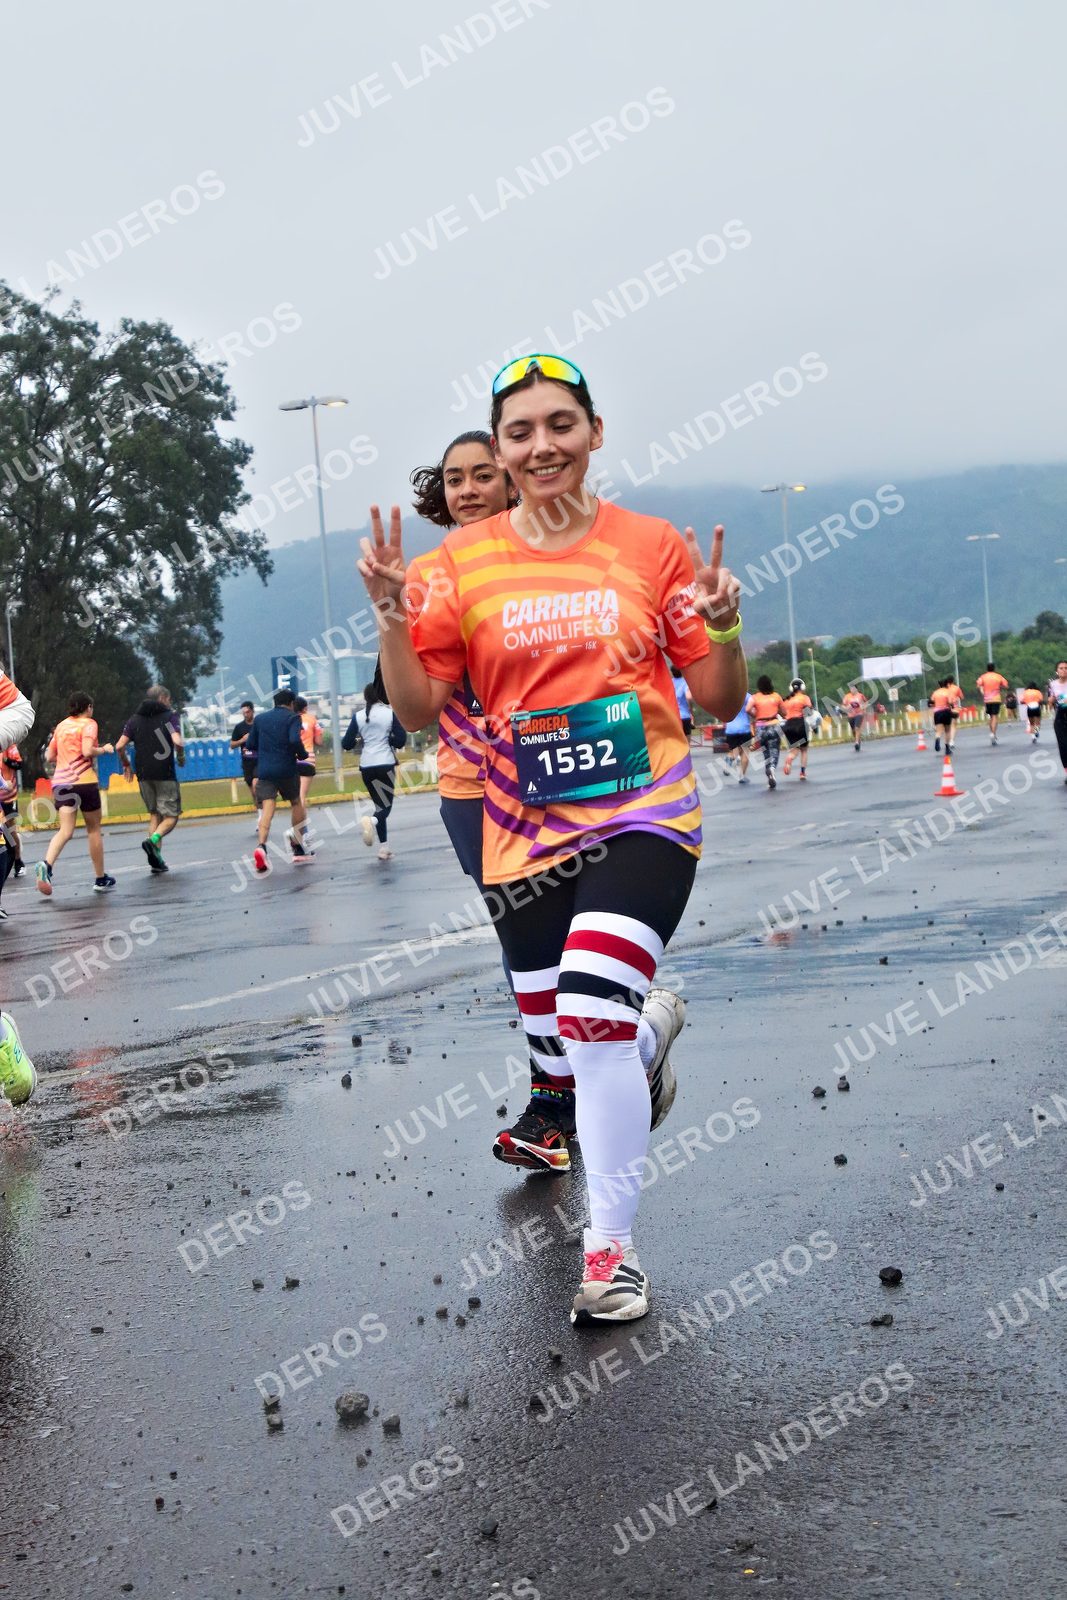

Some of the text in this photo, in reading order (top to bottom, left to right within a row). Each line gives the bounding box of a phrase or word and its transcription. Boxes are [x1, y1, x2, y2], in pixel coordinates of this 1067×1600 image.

[502, 589, 619, 629] CARRERA
[556, 644, 568, 654] 10K
[605, 701, 630, 723] 10K
[518, 714, 569, 736] CARRERA
[537, 739, 617, 776] 1532
